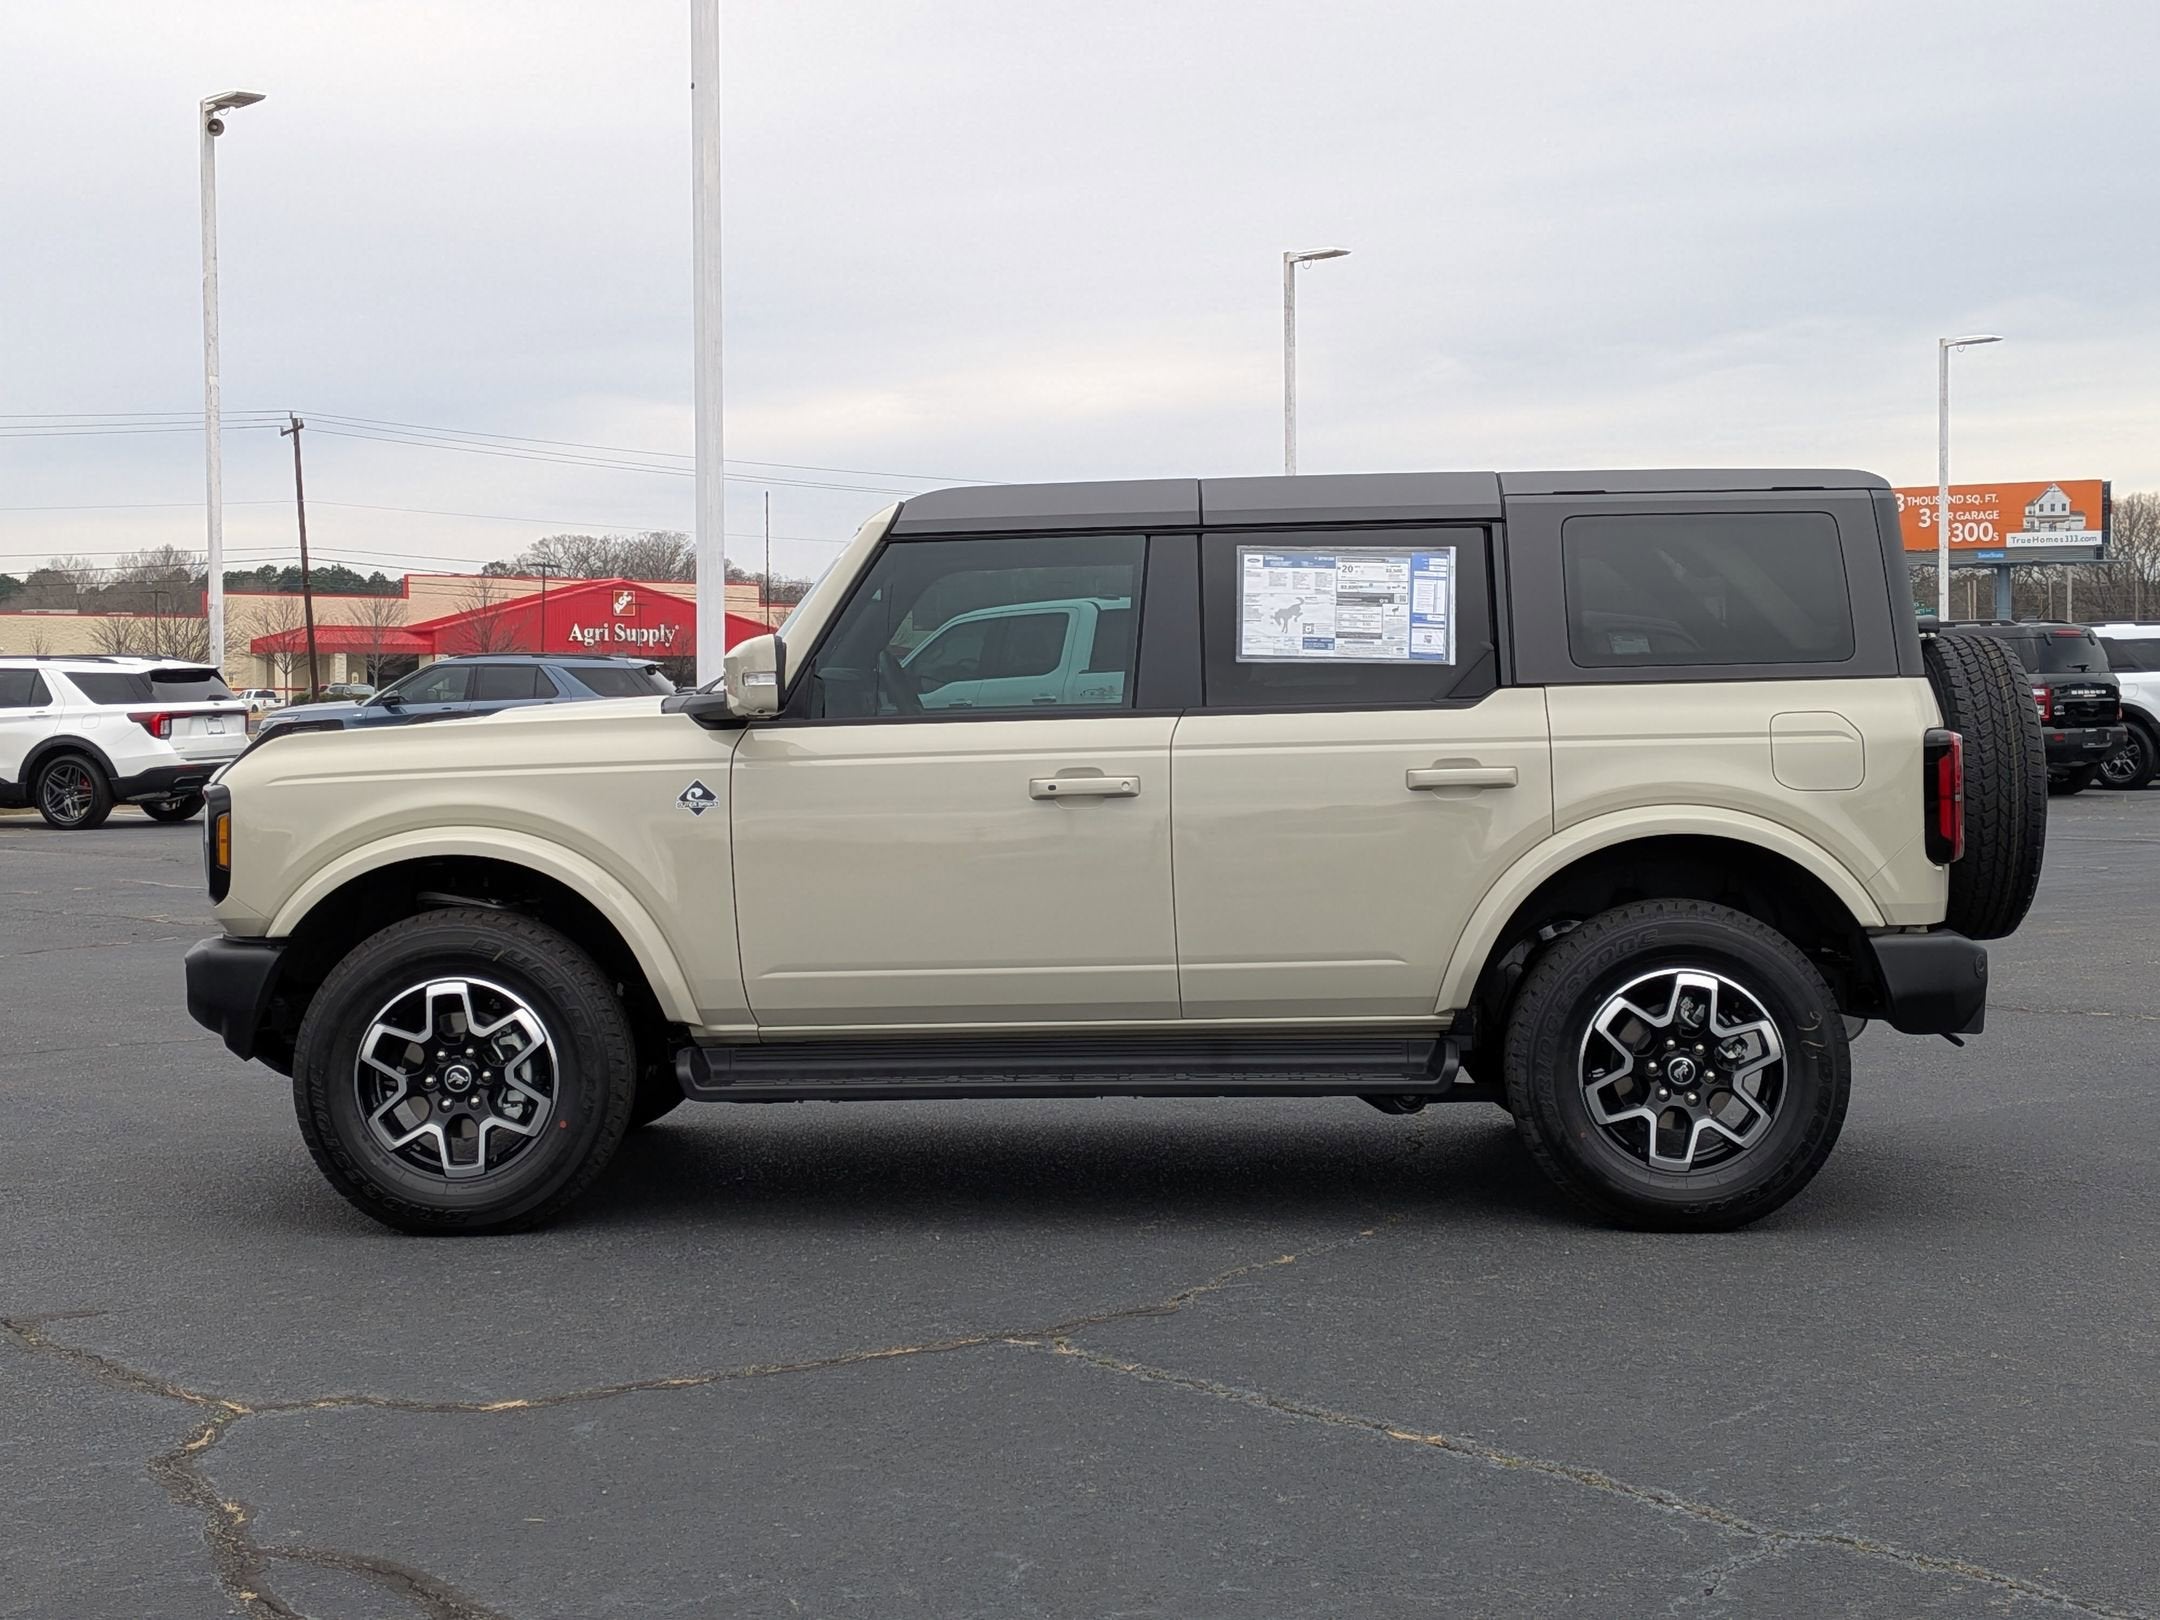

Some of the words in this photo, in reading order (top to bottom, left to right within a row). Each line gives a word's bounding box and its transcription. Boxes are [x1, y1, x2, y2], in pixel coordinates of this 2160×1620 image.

[1895, 493, 1905, 512] 3
[1907, 495, 1963, 506] THOUSND
[1966, 494, 1983, 505] SQ.
[1985, 493, 1999, 503] FT.
[1918, 508, 1931, 527] 3
[1932, 512, 1954, 521] CR
[1956, 510, 2000, 520] GARAGE
[568, 623, 609, 646] Agri
[614, 623, 676, 647] Supply
